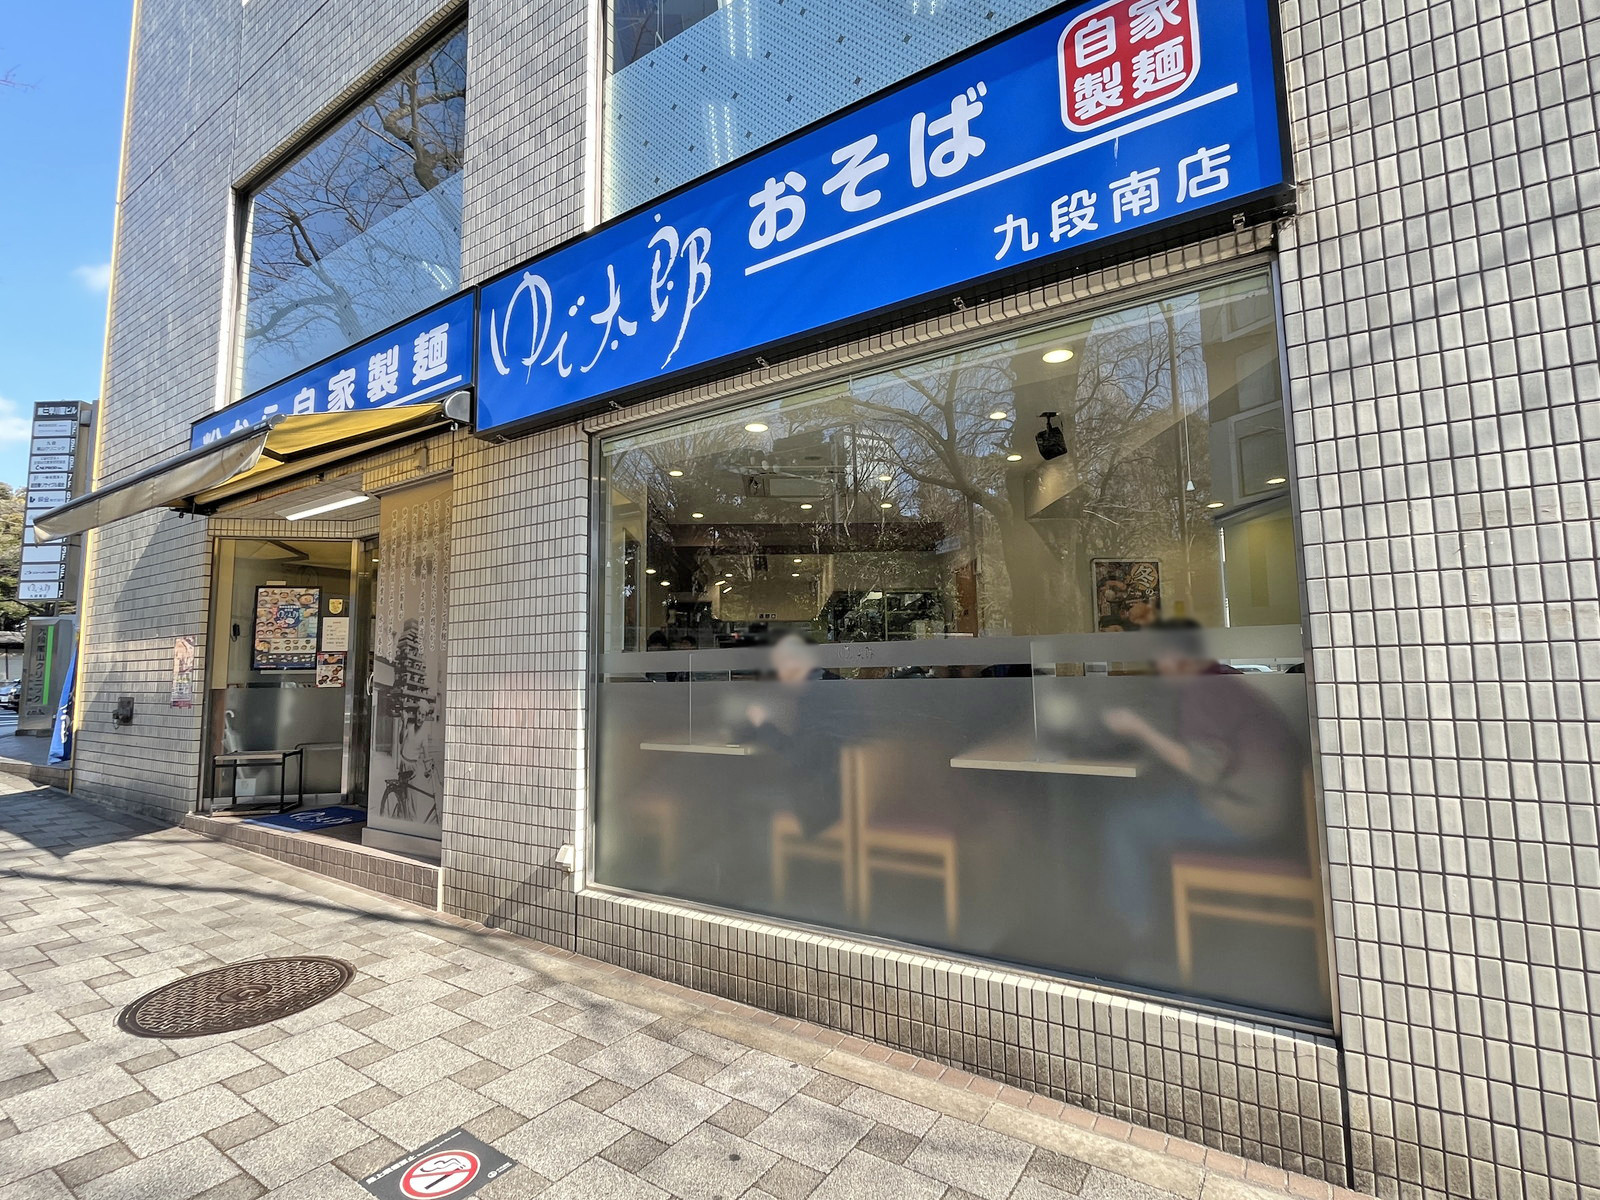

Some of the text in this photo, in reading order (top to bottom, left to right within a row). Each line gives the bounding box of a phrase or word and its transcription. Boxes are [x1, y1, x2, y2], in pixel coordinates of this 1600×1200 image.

[1073, 0, 1183, 68] 自家
[1072, 35, 1187, 121] 製麺
[747, 80, 988, 250] おそば
[993, 143, 1232, 262] 九段南店
[489, 212, 713, 385] ゆで太郎
[202, 322, 449, 446] 自家製麺
[67, 473, 73, 489] 7F
[58, 582, 64, 598] 1F
[60, 564, 66, 579] 2F
[61, 546, 67, 561] 3F
